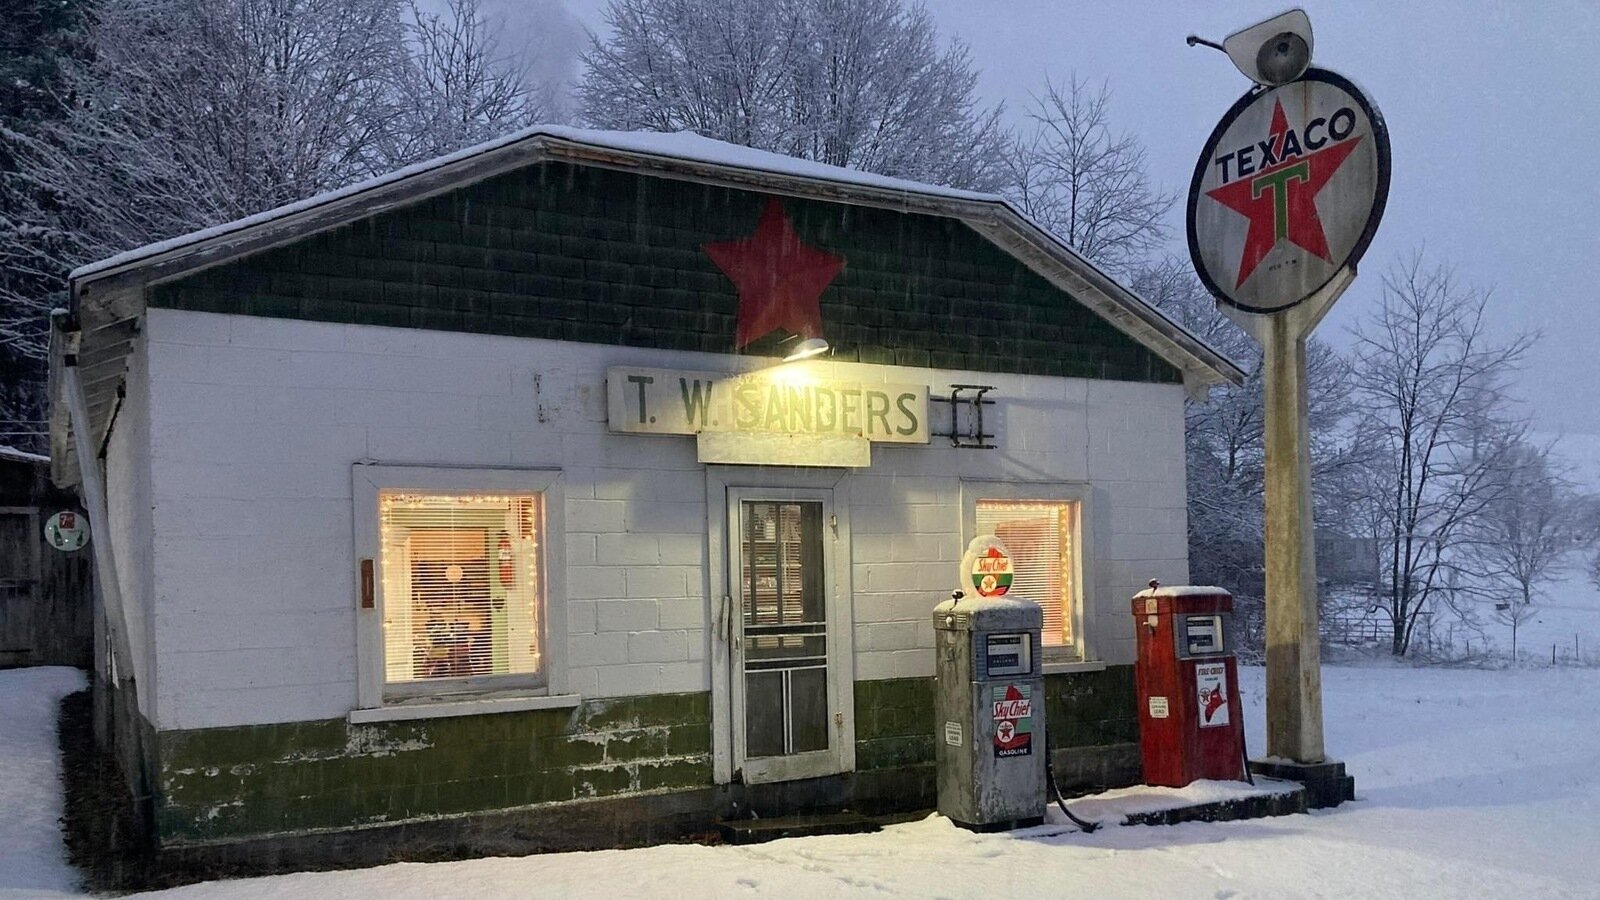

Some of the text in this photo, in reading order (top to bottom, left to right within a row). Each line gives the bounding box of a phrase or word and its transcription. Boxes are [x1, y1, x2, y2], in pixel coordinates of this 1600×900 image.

[1216, 107, 1356, 183] TEXACO
[1253, 161, 1310, 240] T
[628, 375, 918, 436] T. W. SANDERS
[993, 700, 1031, 718] Sky Chief
[999, 748, 1028, 756] GASOLINE
